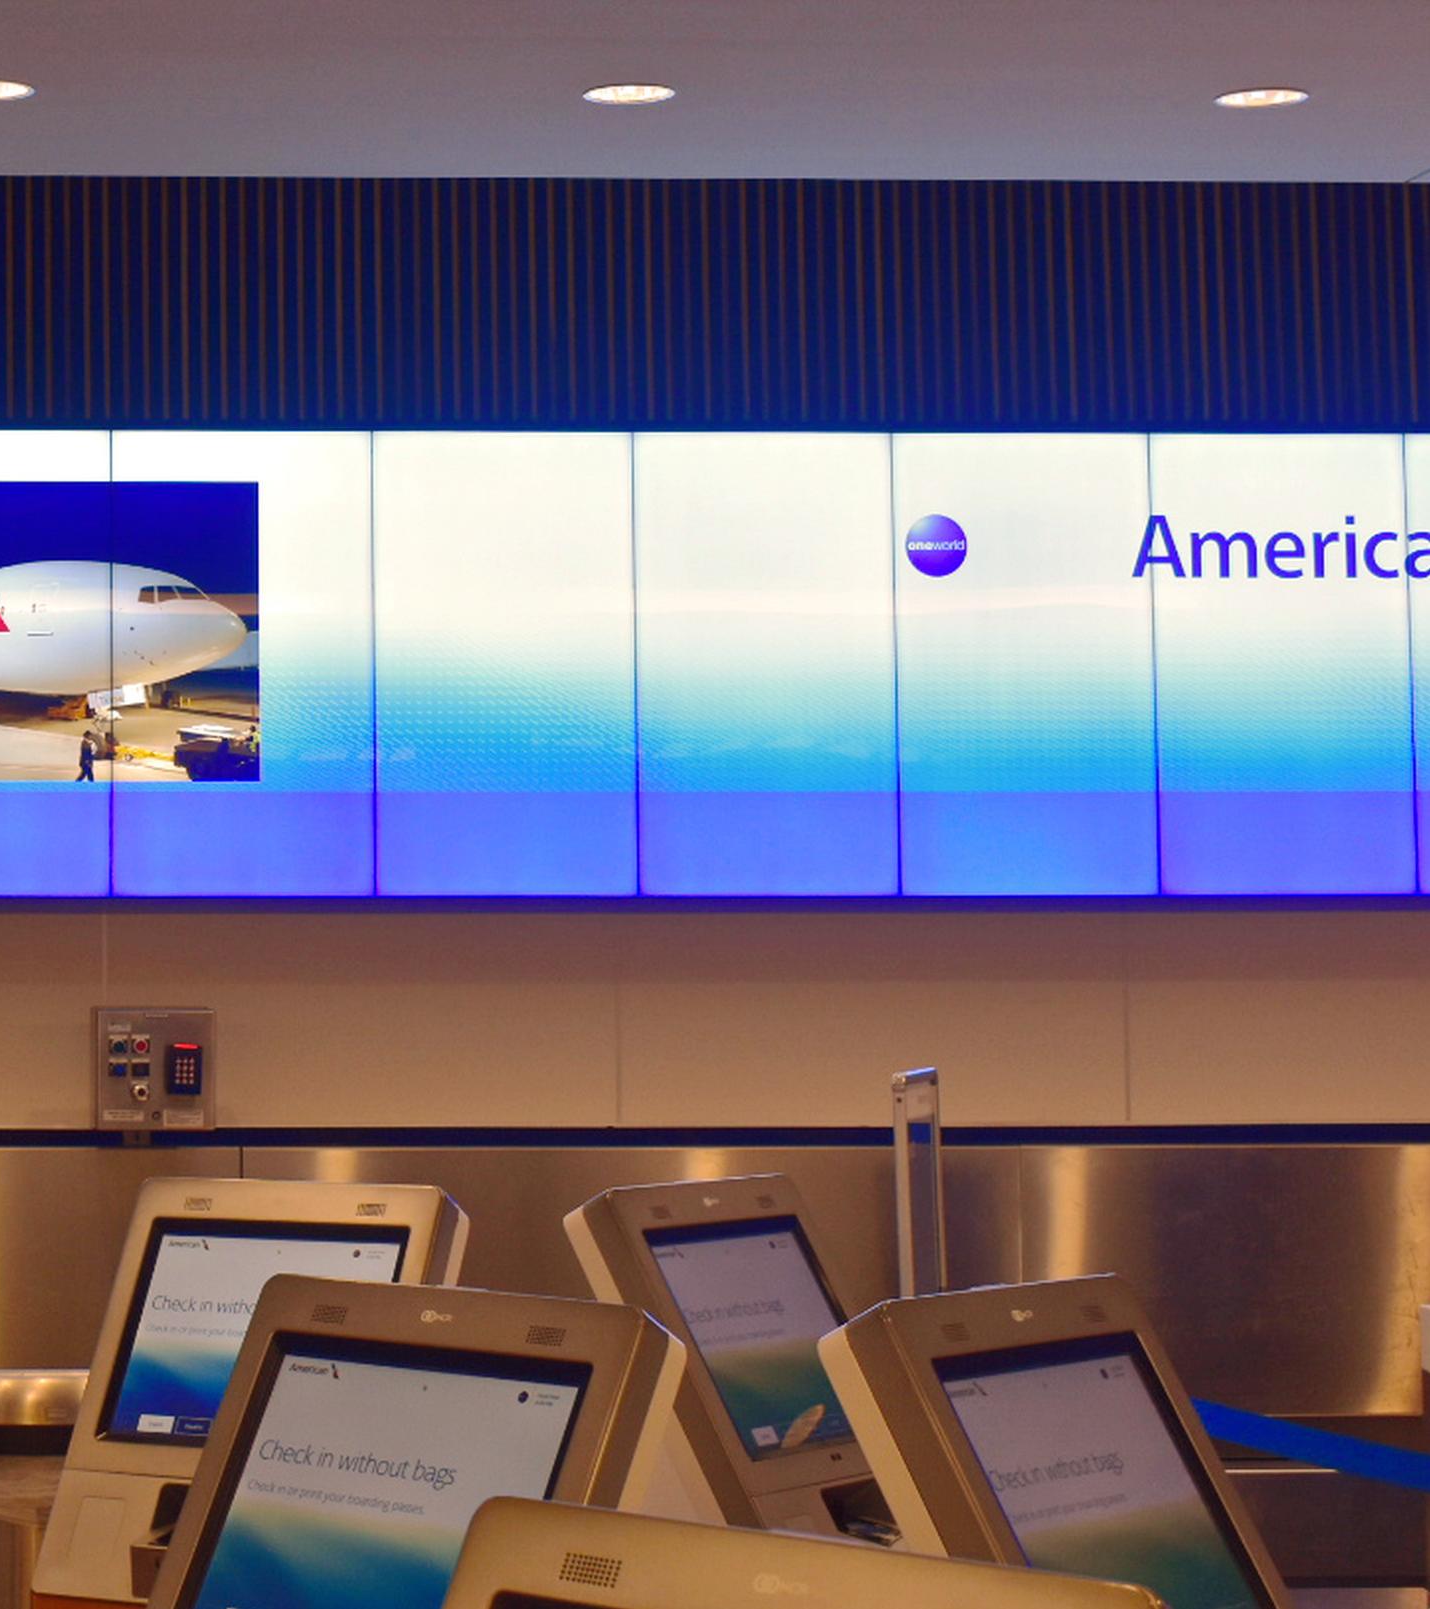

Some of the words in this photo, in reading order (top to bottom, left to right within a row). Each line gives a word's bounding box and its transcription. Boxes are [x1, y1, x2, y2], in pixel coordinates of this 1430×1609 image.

[908, 539, 964, 550] oneworld
[152, 1295, 197, 1312] Check
[200, 1299, 212, 1312] in
[259, 1439, 315, 1466] Check
[317, 1447, 334, 1469] in
[338, 1452, 410, 1480] without
[412, 1459, 458, 1491] bags
[248, 1479, 275, 1493] Check
[299, 1487, 322, 1500] print
[324, 1491, 345, 1504] your
[347, 1492, 390, 1513] boarding
